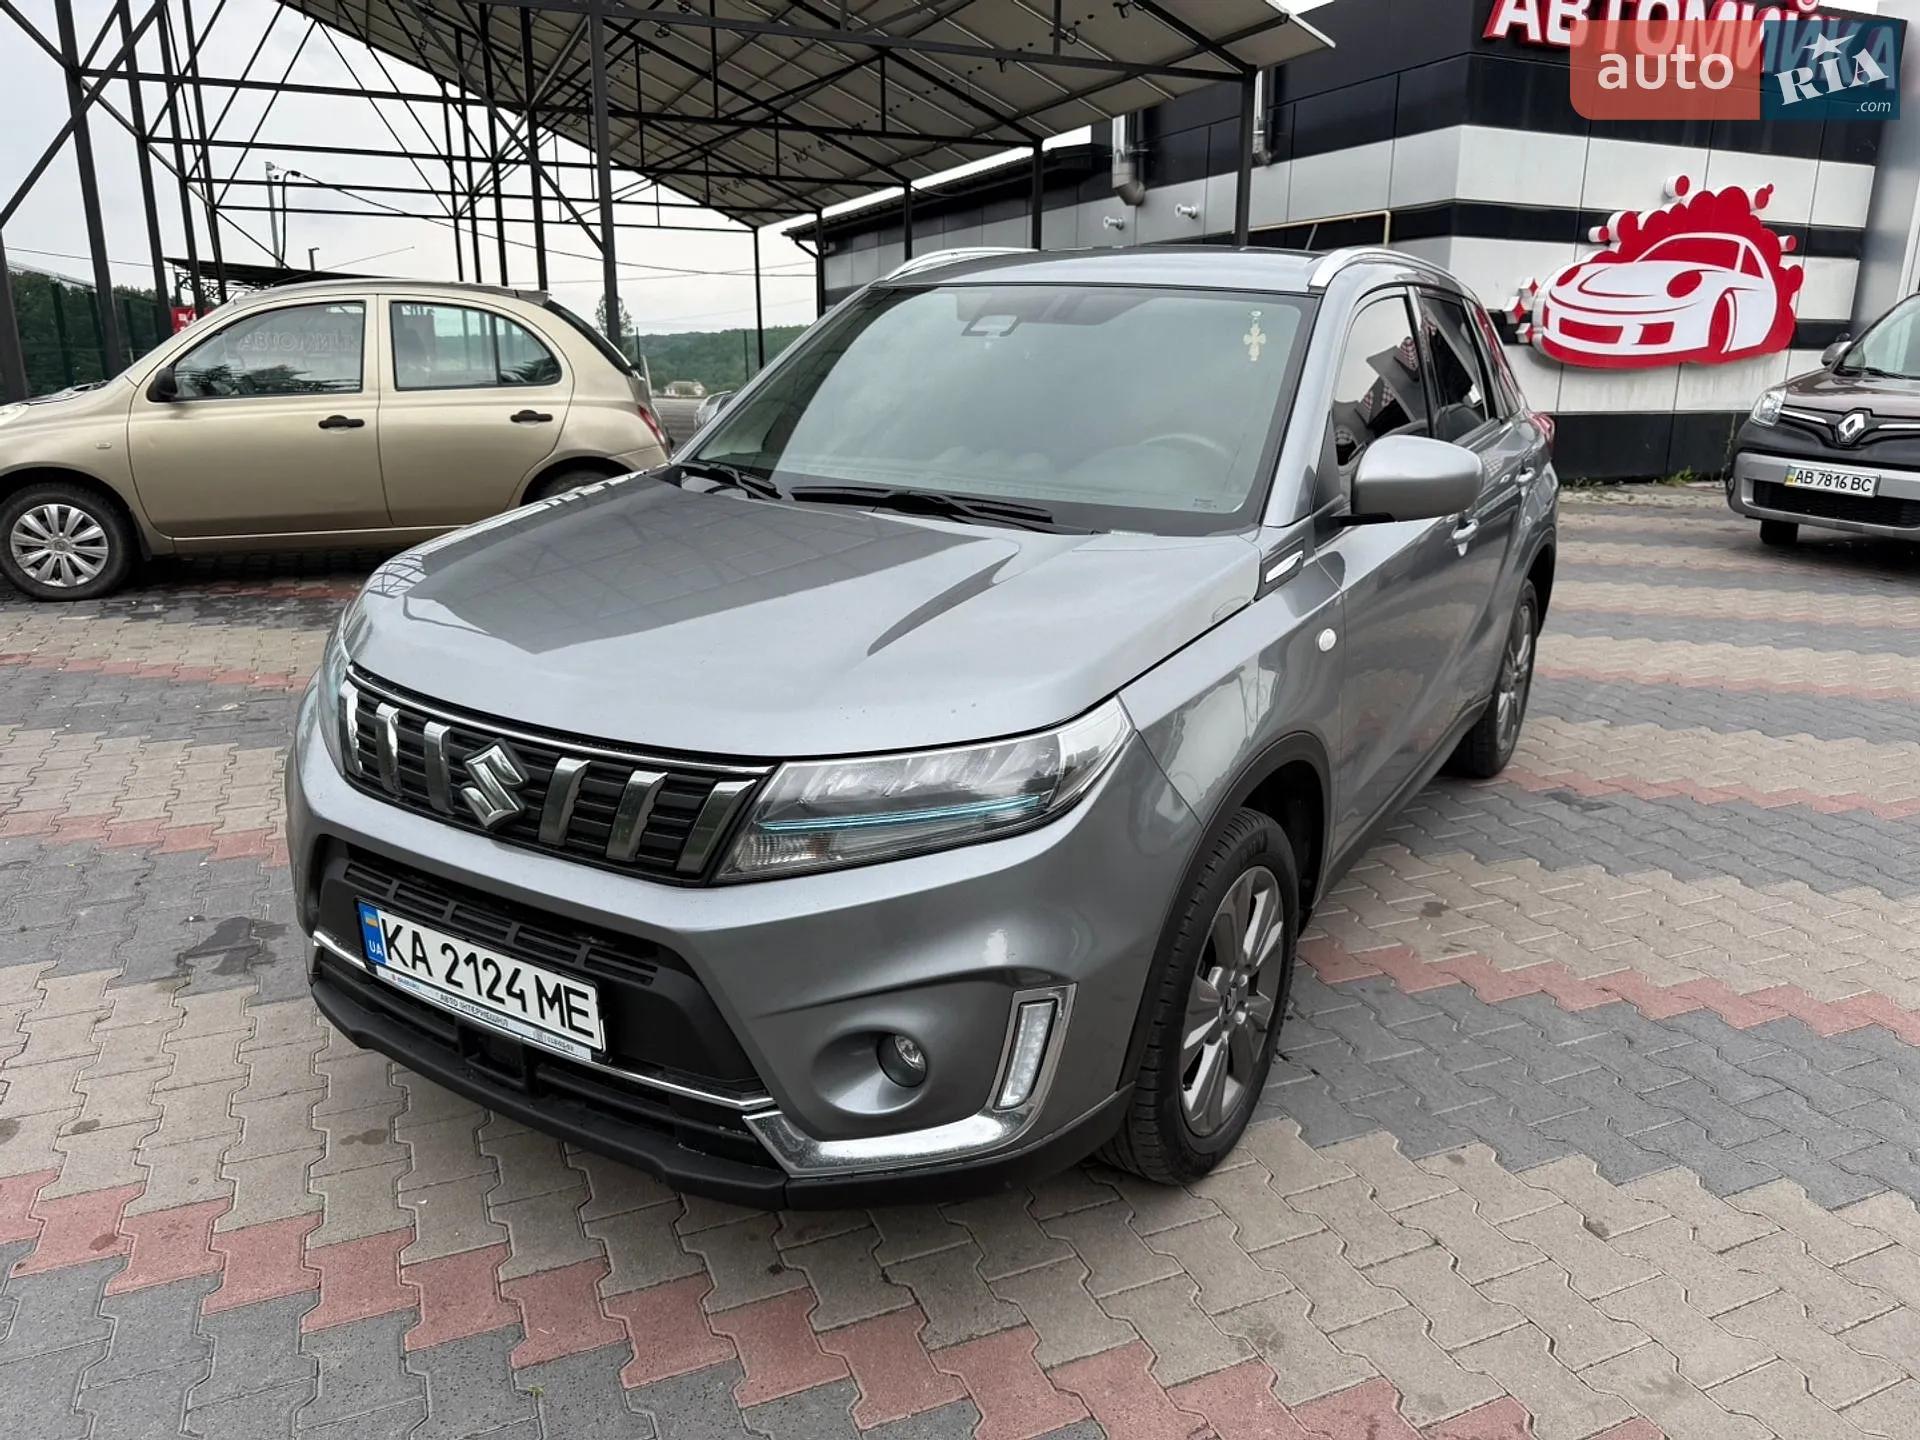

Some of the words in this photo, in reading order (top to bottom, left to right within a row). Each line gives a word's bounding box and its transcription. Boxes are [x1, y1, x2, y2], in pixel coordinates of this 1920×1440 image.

[1795, 470, 1814, 484] AB
[1816, 473, 1848, 489] 7816
[1851, 477, 1872, 492] BC
[368, 939, 384, 957] UA
[381, 918, 434, 977] KA
[440, 943, 528, 1013] 2124
[535, 974, 595, 1039] ME
